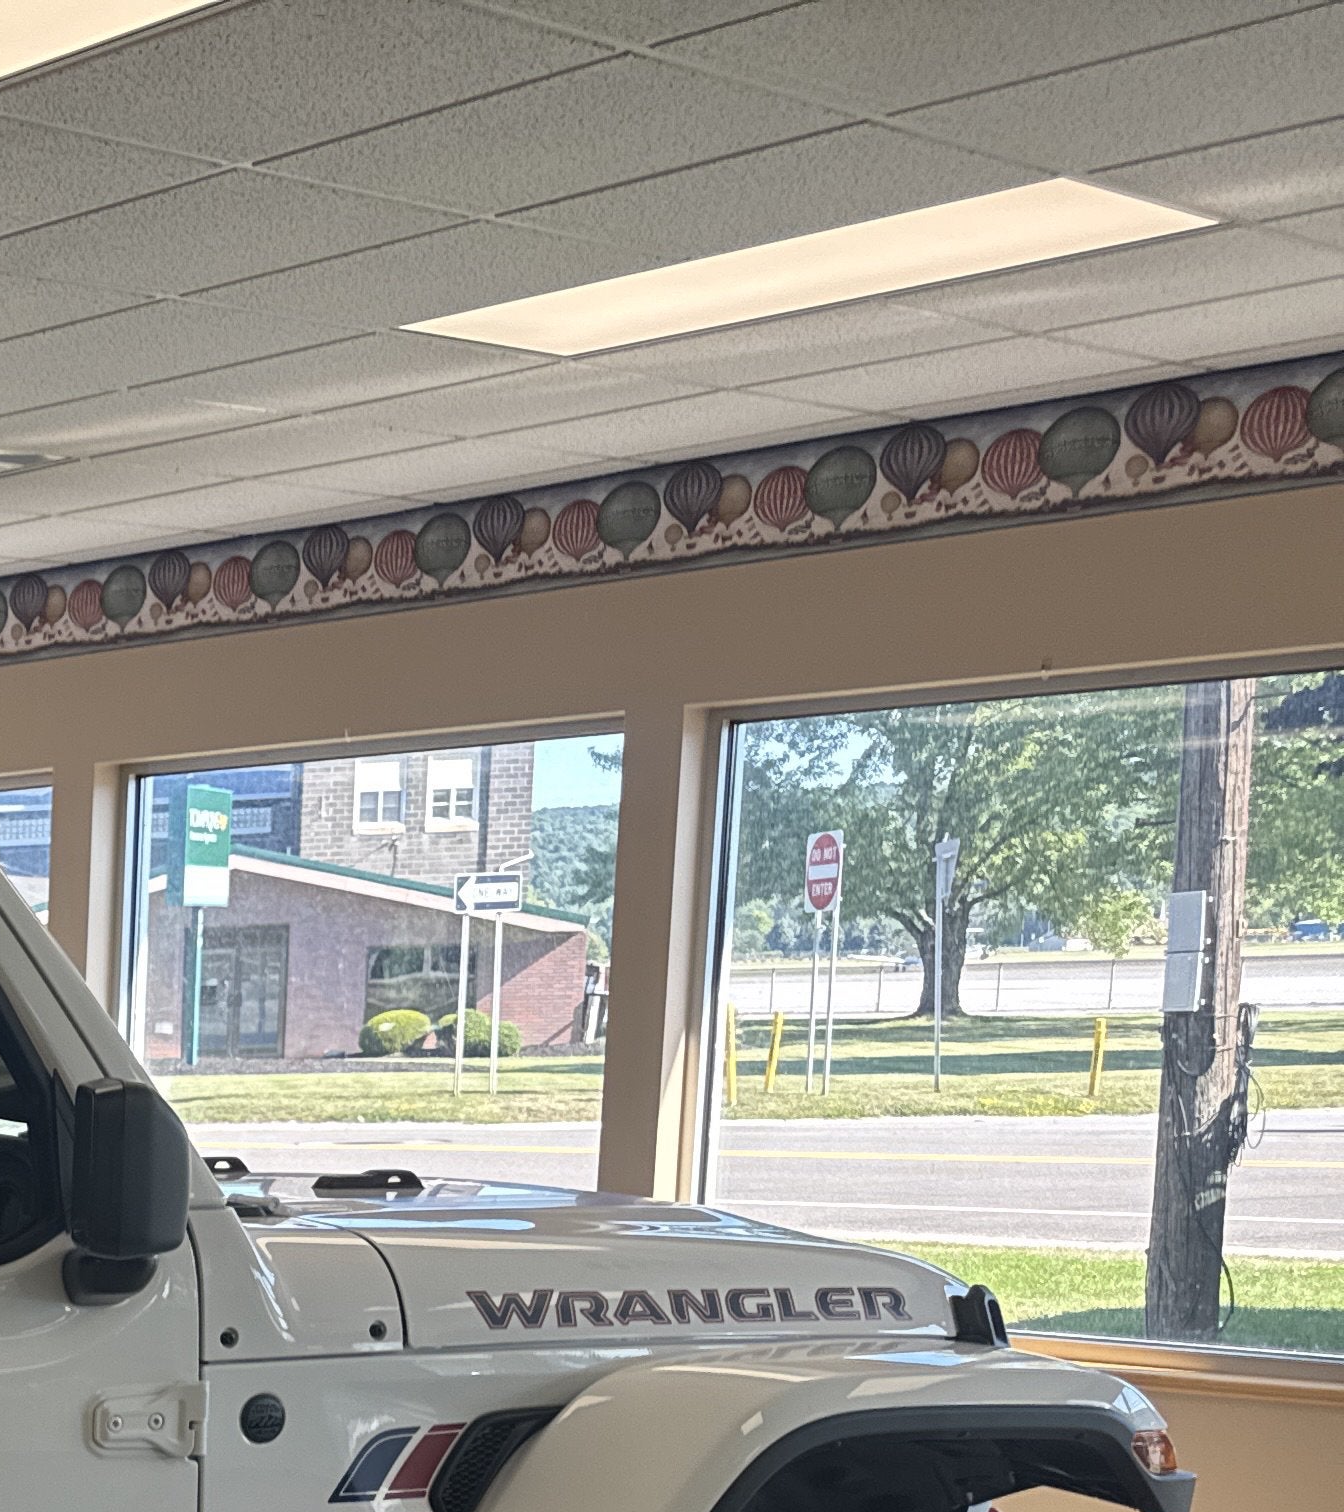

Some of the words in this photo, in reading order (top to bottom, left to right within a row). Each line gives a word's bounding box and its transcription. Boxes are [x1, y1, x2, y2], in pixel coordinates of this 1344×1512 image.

[812, 848, 821, 861] DO
[824, 846, 837, 861] NOT
[812, 882, 832, 896] ENTER
[466, 1288, 912, 1330] WRANGLER
